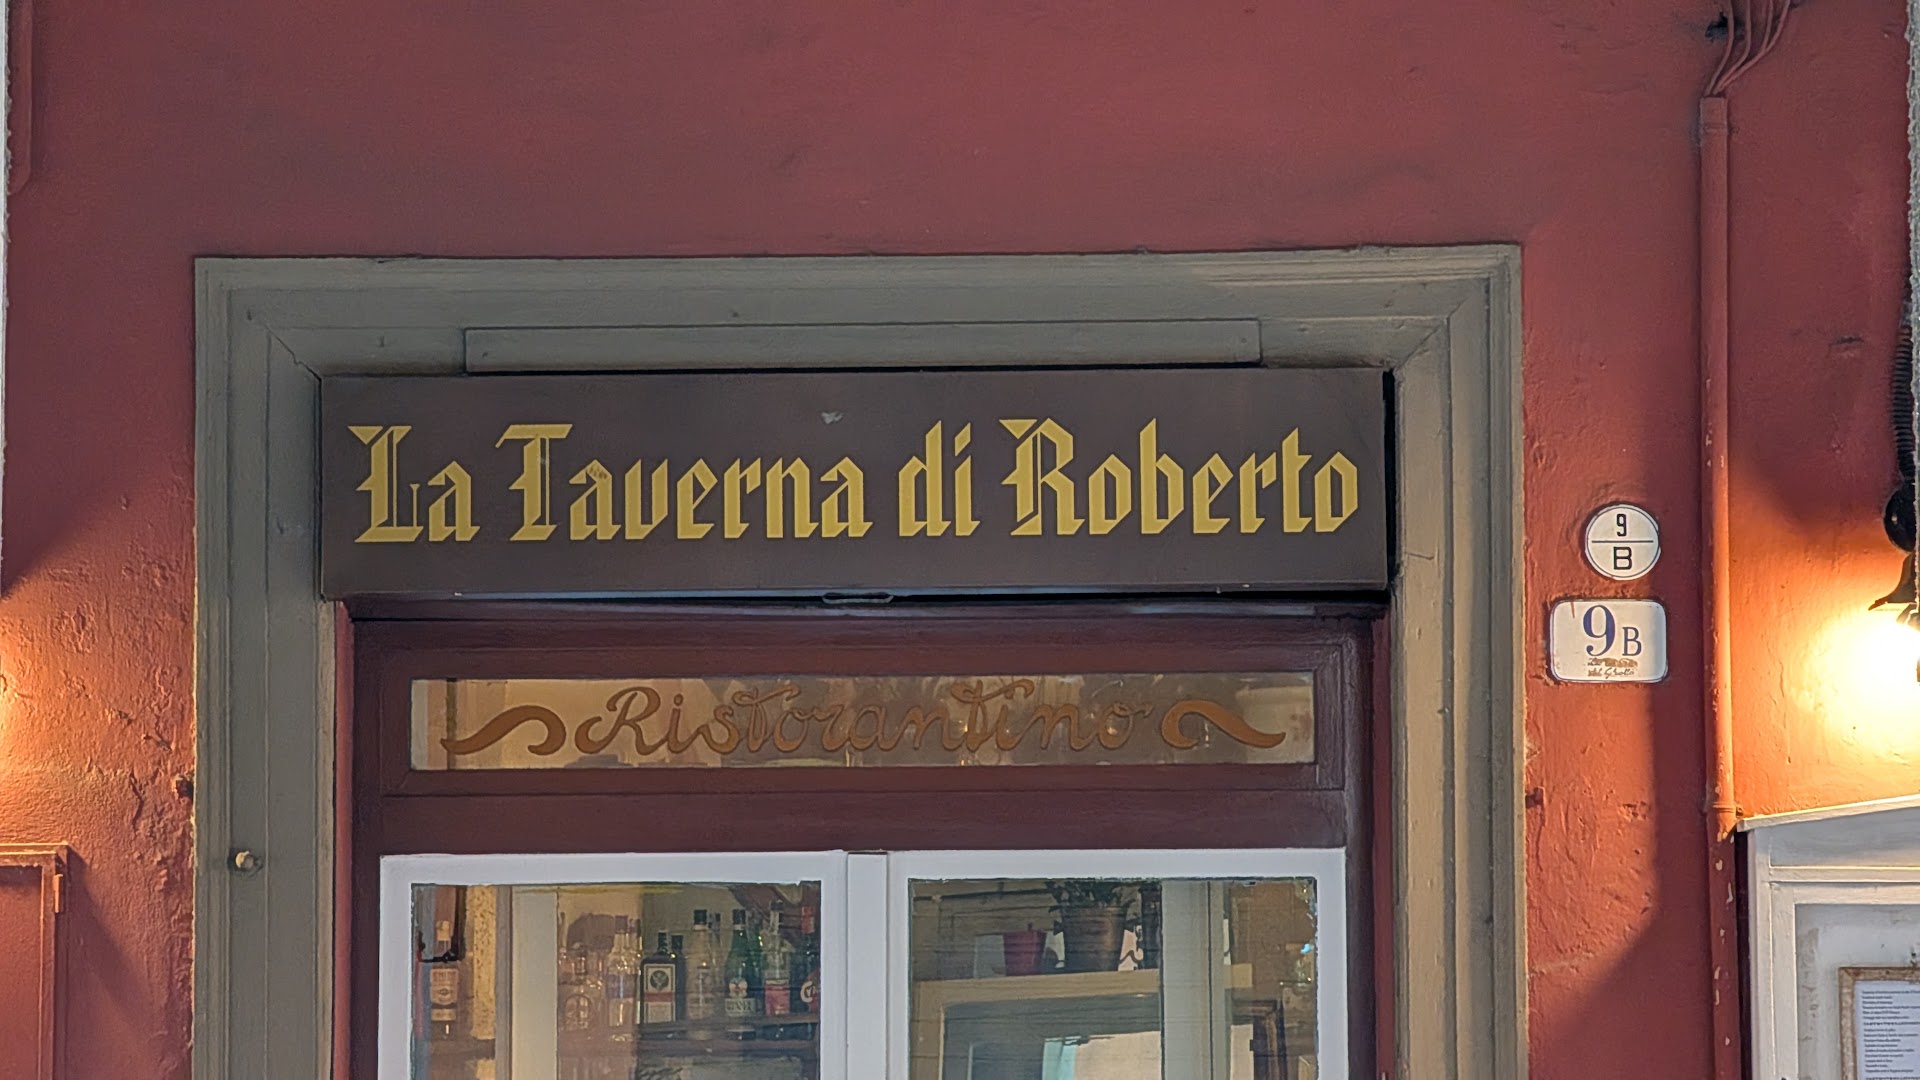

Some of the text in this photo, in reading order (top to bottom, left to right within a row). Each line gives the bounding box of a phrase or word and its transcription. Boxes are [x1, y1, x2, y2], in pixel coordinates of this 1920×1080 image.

[347, 417, 1359, 543] La Taverna di Roberto
[1616, 513, 1627, 537] 9
[1612, 546, 1633, 571] B
[574, 679, 1153, 756] Ristorantino
